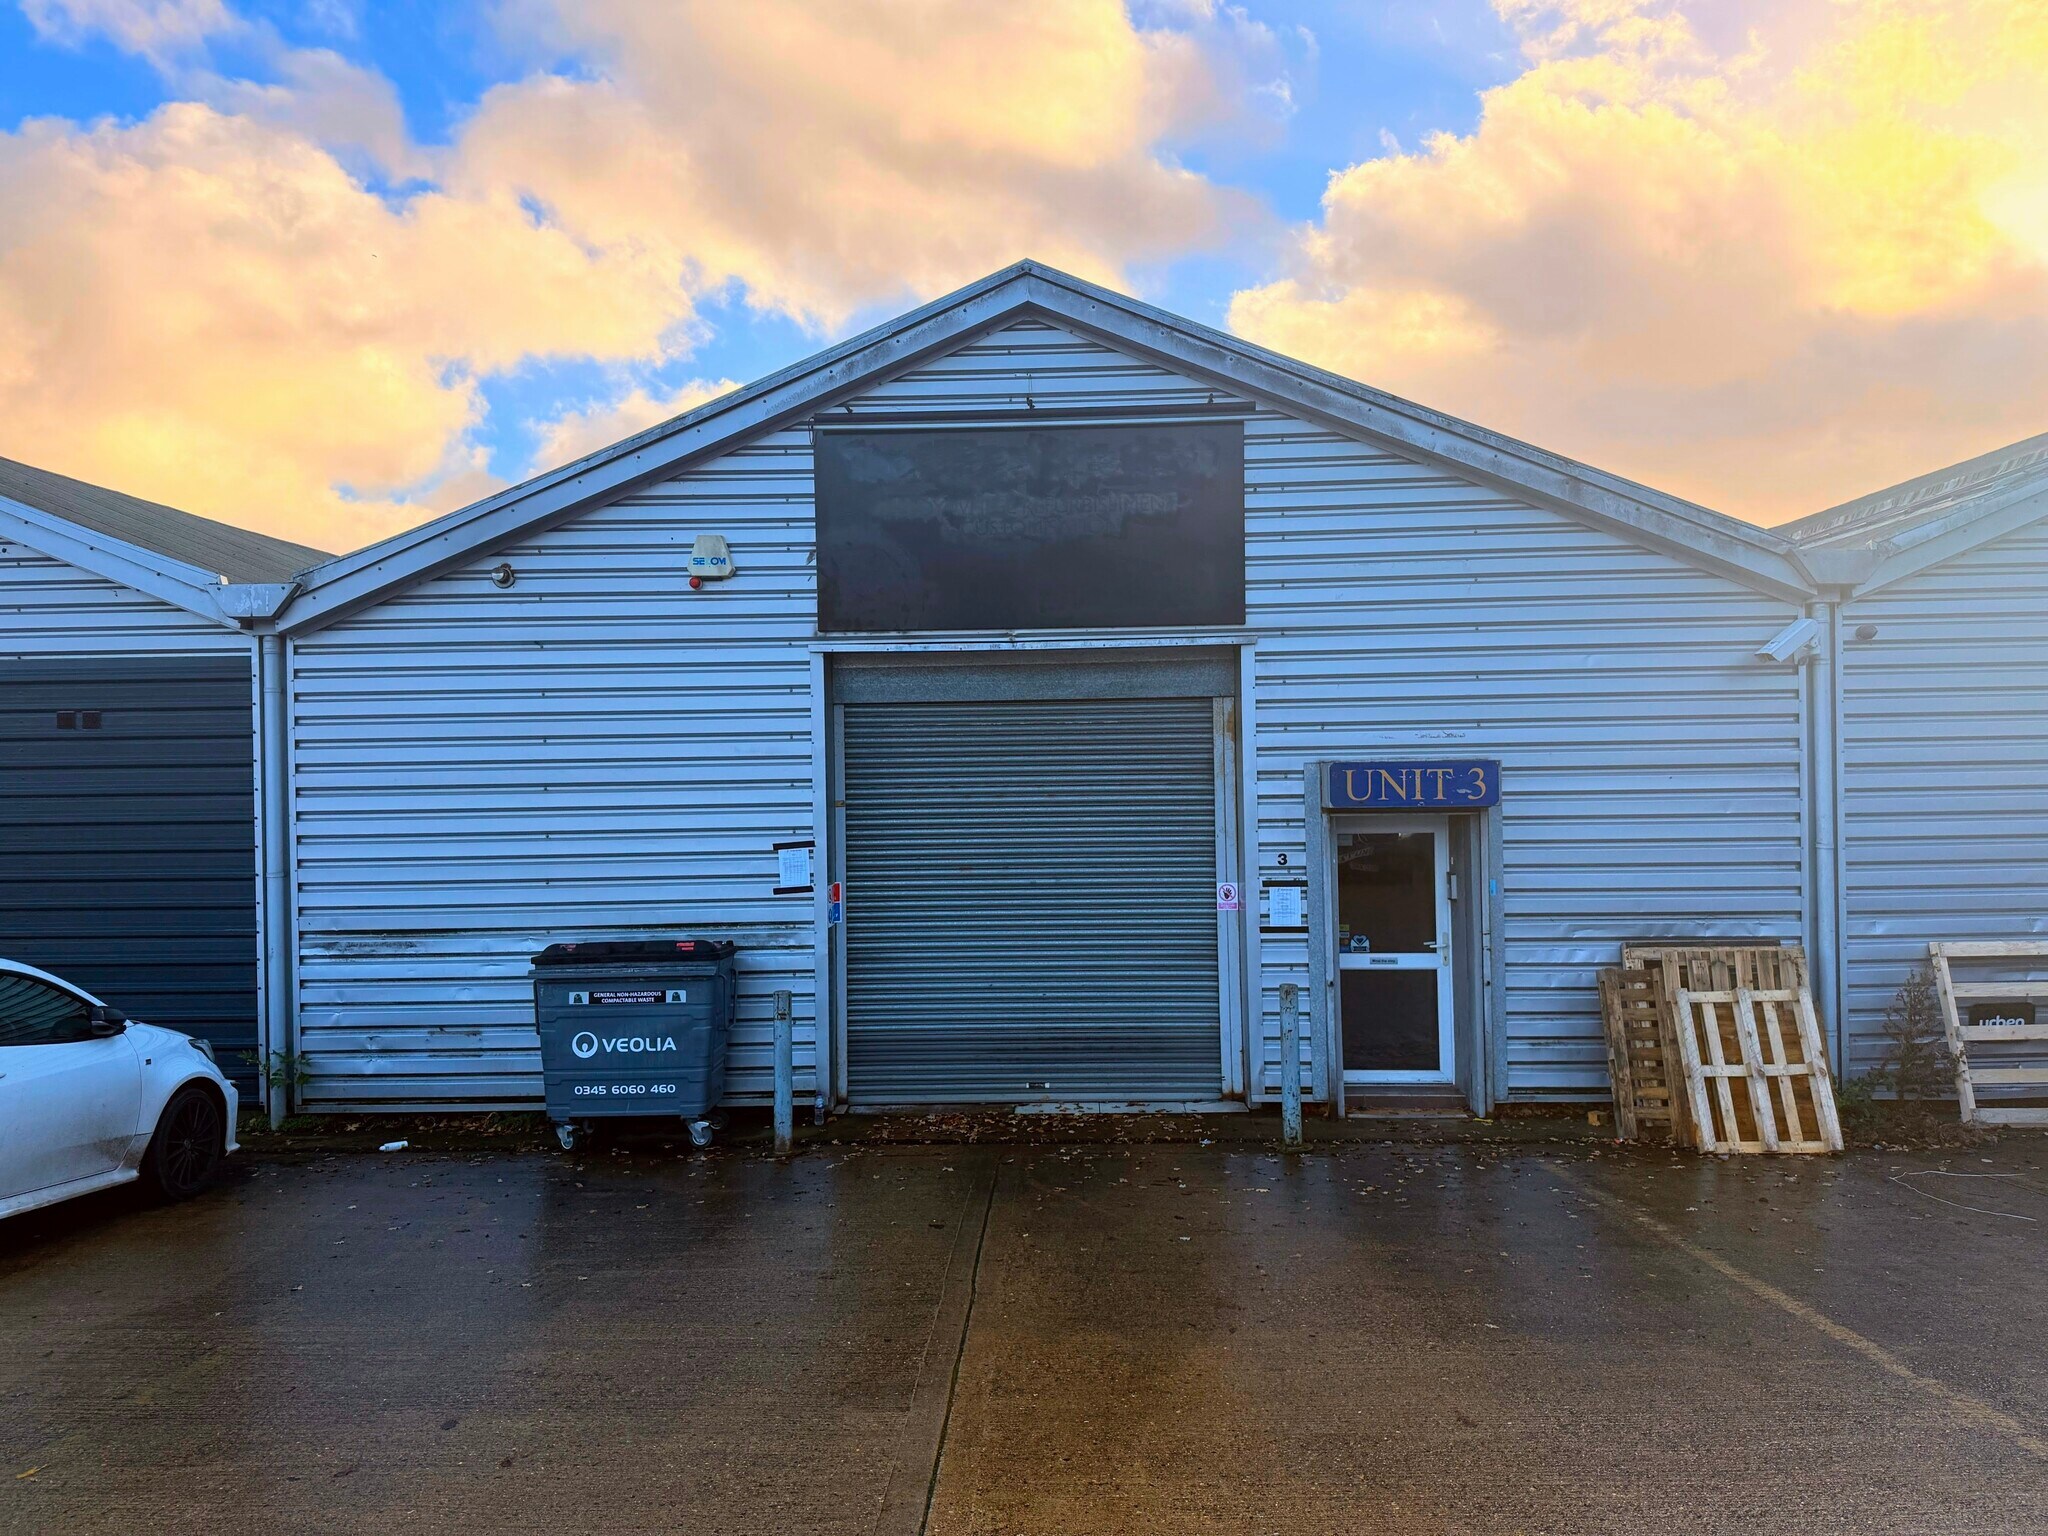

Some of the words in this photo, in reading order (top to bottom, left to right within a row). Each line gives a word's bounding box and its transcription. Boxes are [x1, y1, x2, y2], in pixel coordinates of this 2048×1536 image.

[692, 557, 726, 566] SEOM
[1342, 768, 1453, 801] UNIT
[1467, 767, 1487, 800] 3
[1277, 853, 1288, 866] 3
[602, 1037, 677, 1052] VEOLIA
[574, 1085, 607, 1095] 0345
[611, 1084, 645, 1095] 6060
[650, 1084, 676, 1094] 460
